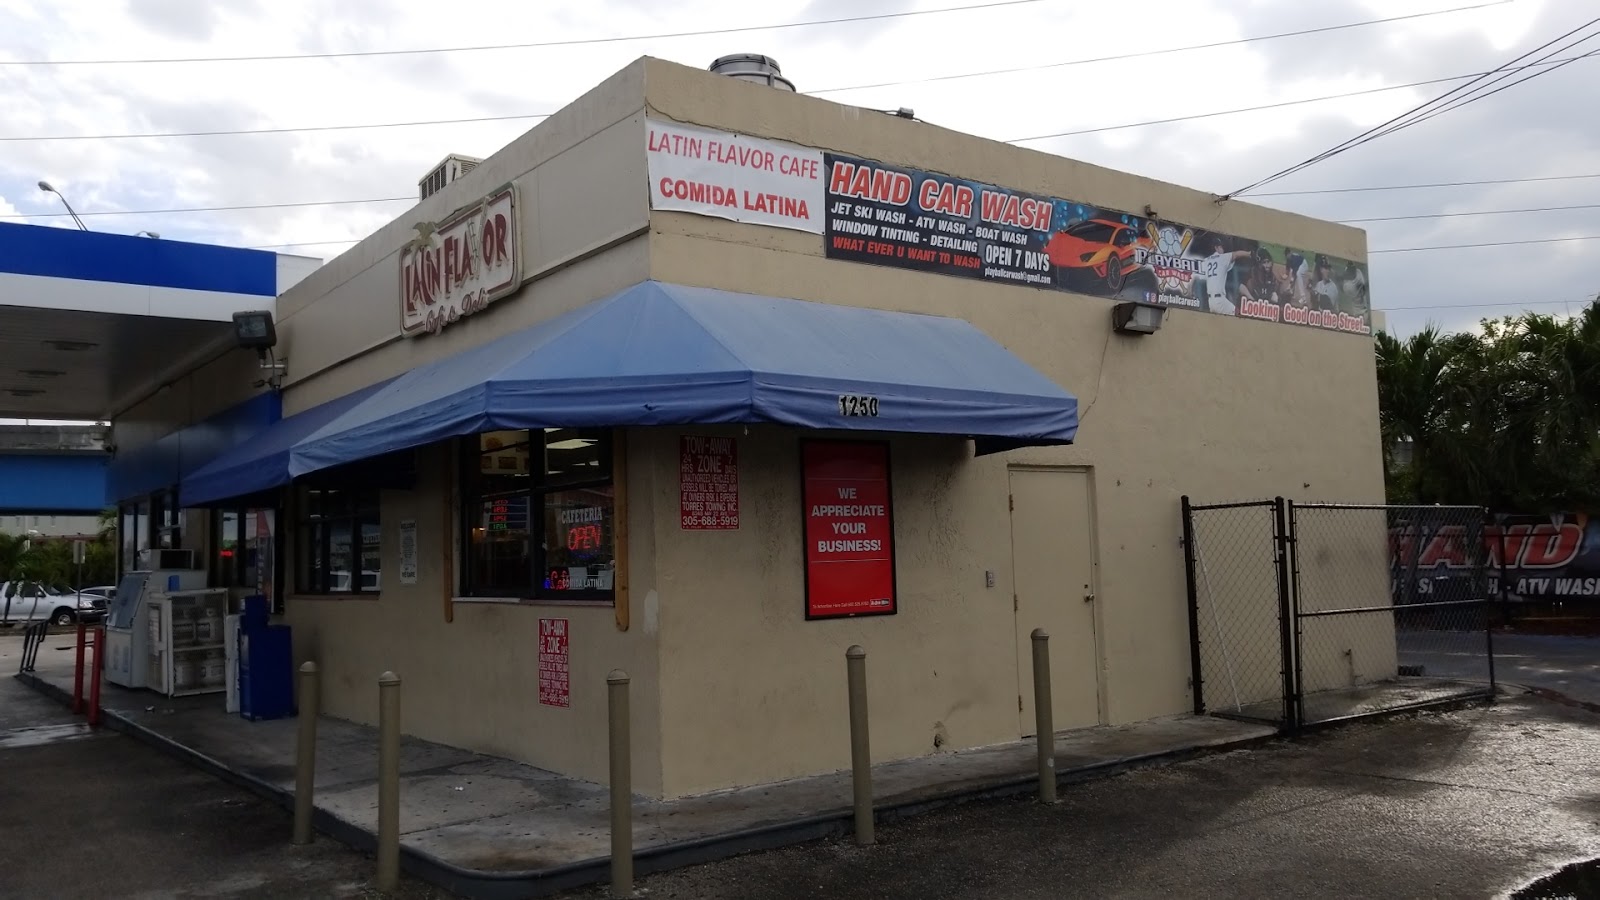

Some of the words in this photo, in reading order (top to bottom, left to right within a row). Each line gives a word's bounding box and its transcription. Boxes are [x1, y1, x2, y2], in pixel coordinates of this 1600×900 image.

[648, 131, 702, 159] LATIN
[707, 141, 774, 172] FLAVOR
[779, 155, 819, 180] CAFE
[660, 177, 738, 208] COMIDA
[743, 190, 810, 220] LATINA
[829, 160, 912, 206] HAND
[918, 179, 974, 218] CAR
[981, 190, 1053, 232] WASH
[831, 201, 852, 215] JET
[853, 205, 873, 219] SKI
[876, 209, 906, 225] WASH
[915, 216, 936, 230] ATV
[938, 220, 966, 235] WASH
[975, 226, 1000, 240] BOAT
[1001, 231, 1028, 245] WASH
[832, 219, 878, 237] WINDOW
[880, 226, 920, 244] TINTING
[930, 235, 978, 253] DETAILING
[833, 236, 865, 251] WHAT
[867, 241, 894, 256] EVER
[897, 246, 905, 257] U
[907, 247, 936, 262] WANT
[938, 251, 951, 264] TO
[953, 254, 981, 269] WASH
[985, 244, 1012, 266] OPEN
[1015, 249, 1022, 267] 7
[1024, 250, 1050, 272] DAYS
[1134, 248, 1206, 276] PLAYBALL
[1207, 261, 1218, 277] 22
[984, 266, 1051, 284] playballcarwash@gmail.com
[1158, 269, 1171, 278] CAR
[1172, 270, 1190, 281] WASH
[1158, 293, 1200, 308] playballcarwash
[1240, 296, 1280, 322] Looking
[1283, 303, 1308, 325] Good
[1308, 310, 1321, 327] on
[1322, 309, 1337, 328] the
[840, 395, 879, 417] 1250
[684, 436, 732, 455] TOW-AWAY
[681, 463, 694, 473] HRS
[682, 453, 692, 463] 24
[697, 455, 722, 473] ZONE
[728, 455, 733, 465] 7
[838, 487, 857, 500] WE
[561, 506, 603, 524] CAFETERIA
[682, 501, 704, 511] TORRES
[705, 502, 726, 512] TOWING
[811, 505, 885, 517] APPRECIATE
[682, 515, 739, 526] 305-688-5919
[832, 522, 867, 534] YOUR
[567, 524, 602, 550] OPEN
[817, 539, 882, 553] BUSINESS!
[583, 578, 603, 588] LATINA
[1516, 578, 1551, 595] ATV
[547, 636, 560, 653] ZONE
